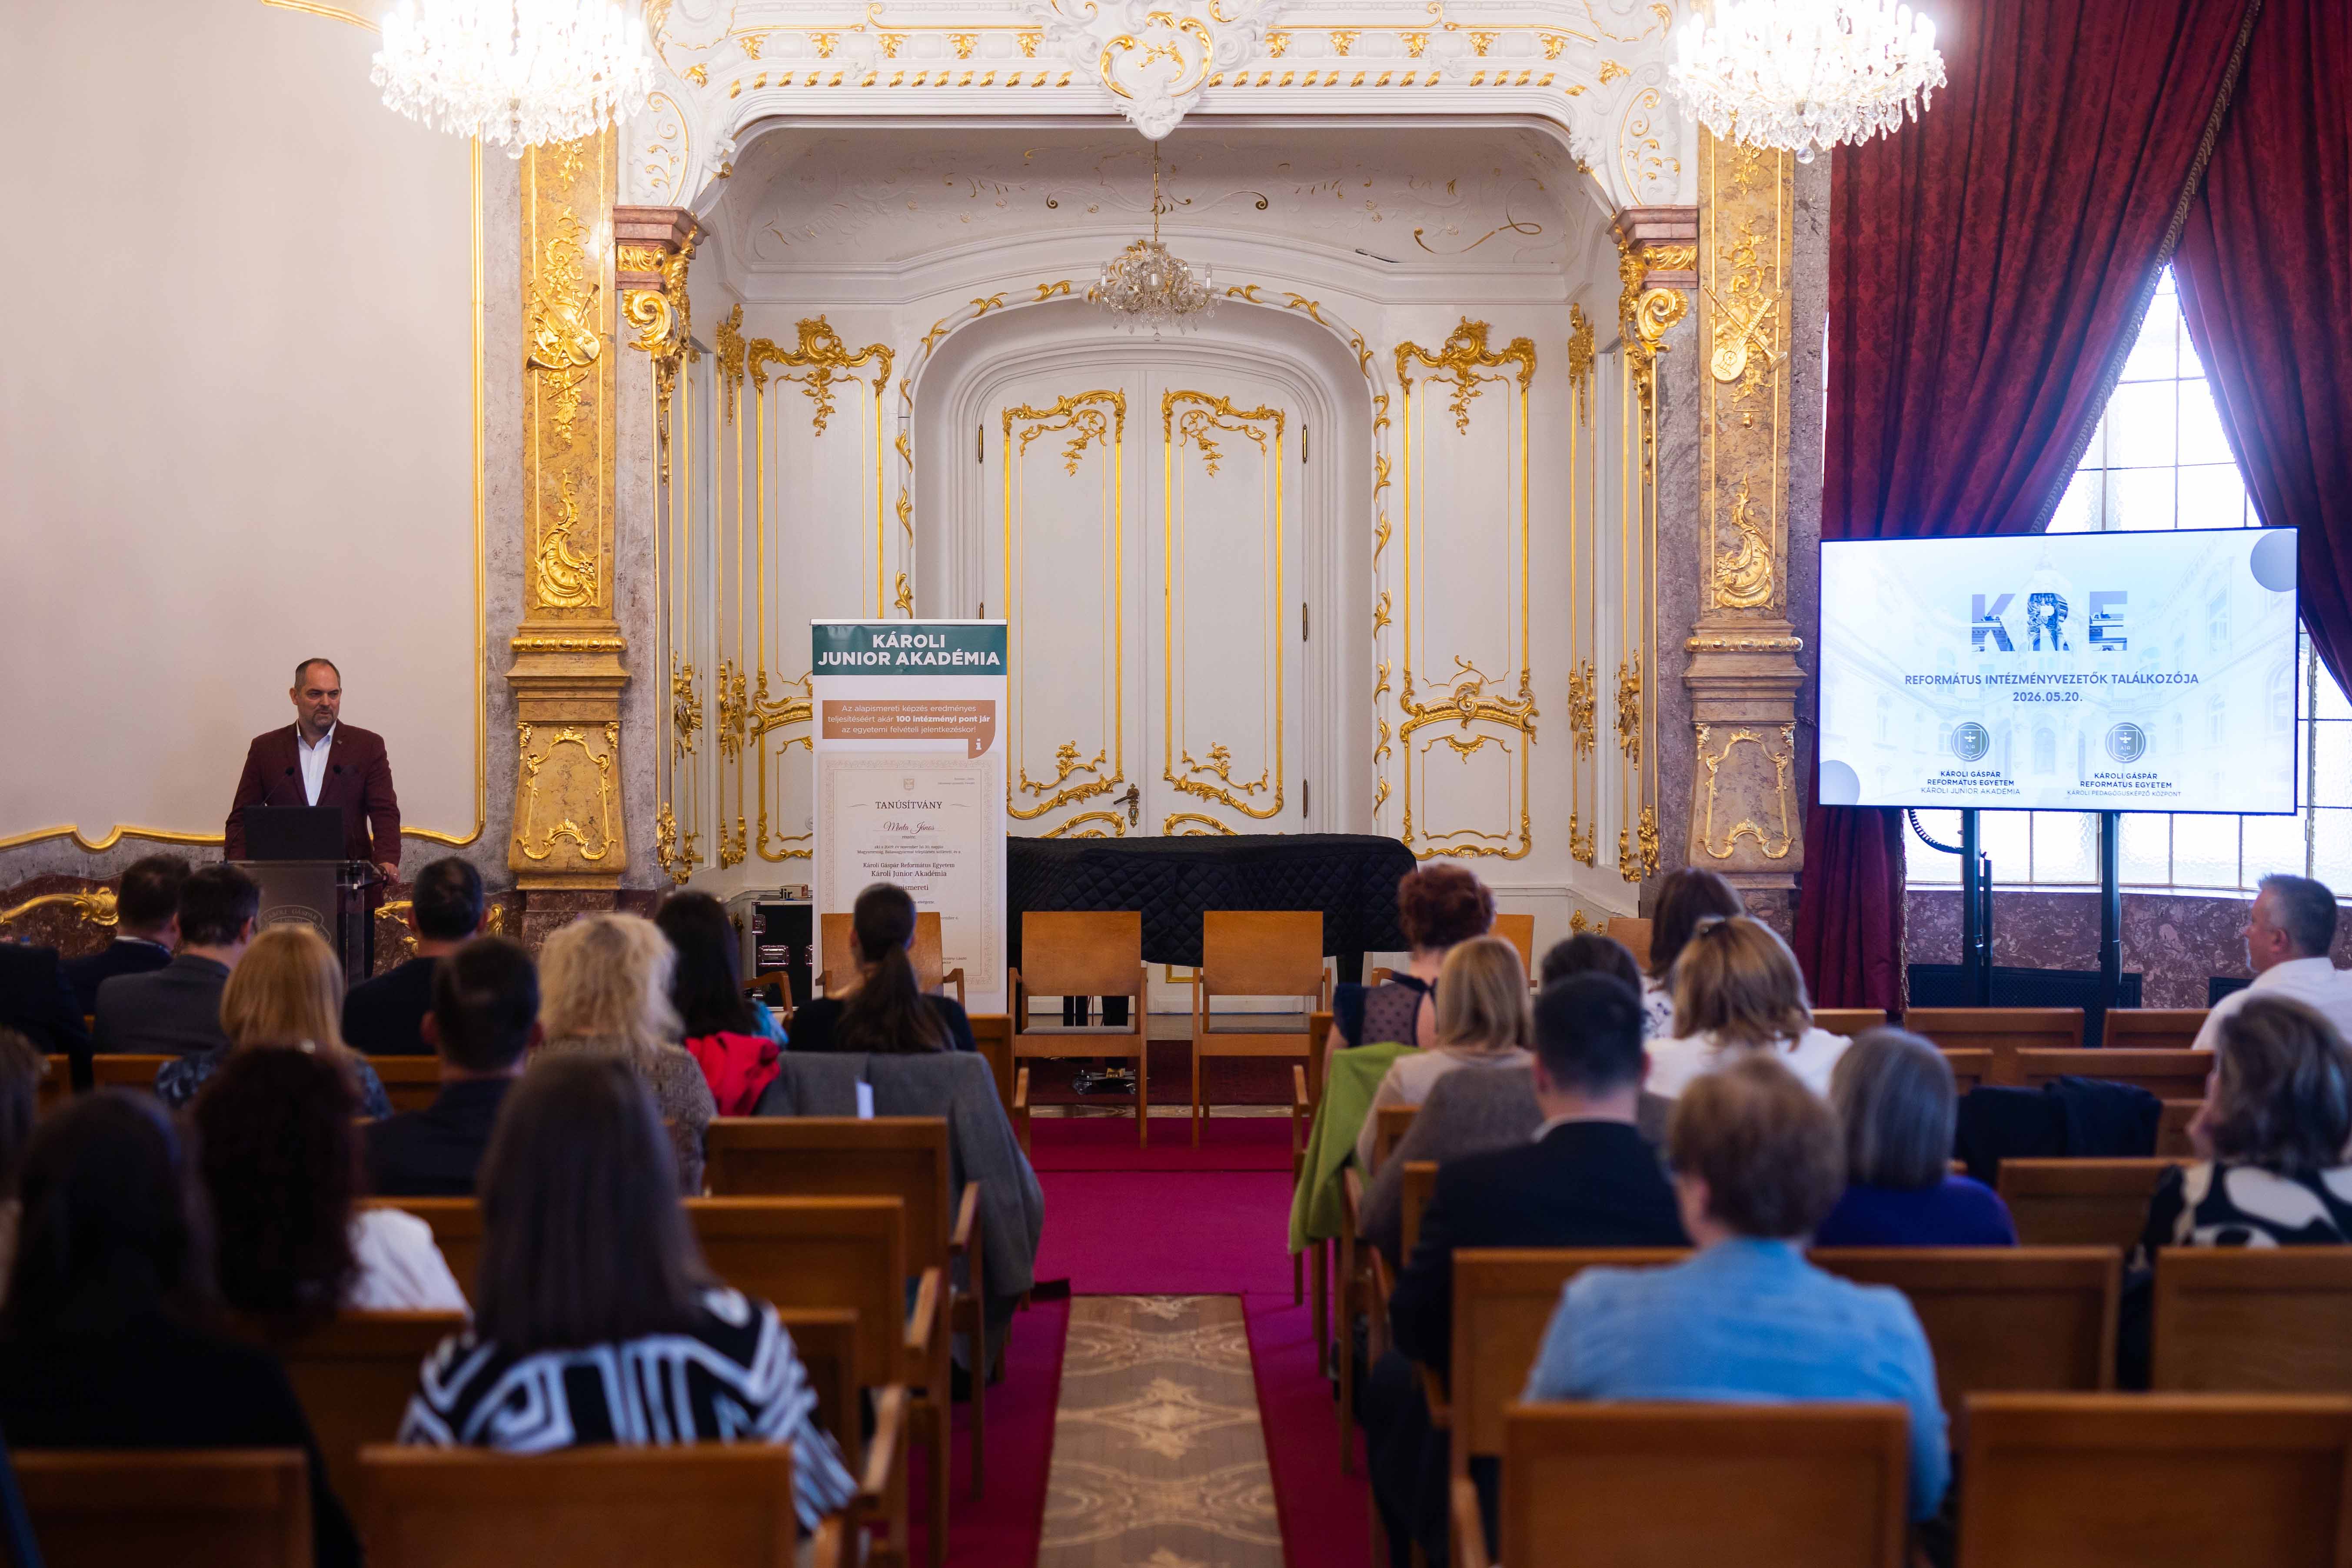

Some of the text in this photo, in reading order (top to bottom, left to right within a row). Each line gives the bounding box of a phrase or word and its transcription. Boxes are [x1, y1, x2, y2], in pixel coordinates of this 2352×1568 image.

[873, 632, 945, 648] KÁROLI
[818, 649, 1000, 665] JUNIOR AKADÉMIA
[1905, 672, 2199, 685] REFORMÁTUS INTÉZMÉNYVEZETŐK TALÁLKOZÓJA
[2013, 692, 2083, 702] 2026.05.20.
[855, 705, 900, 713] alapismereti
[902, 705, 928, 713] képzés
[931, 705, 976, 713] eredményes
[875, 800, 942, 809] TANÚSÍTVÁNY
[883, 821, 935, 834] Minta János
